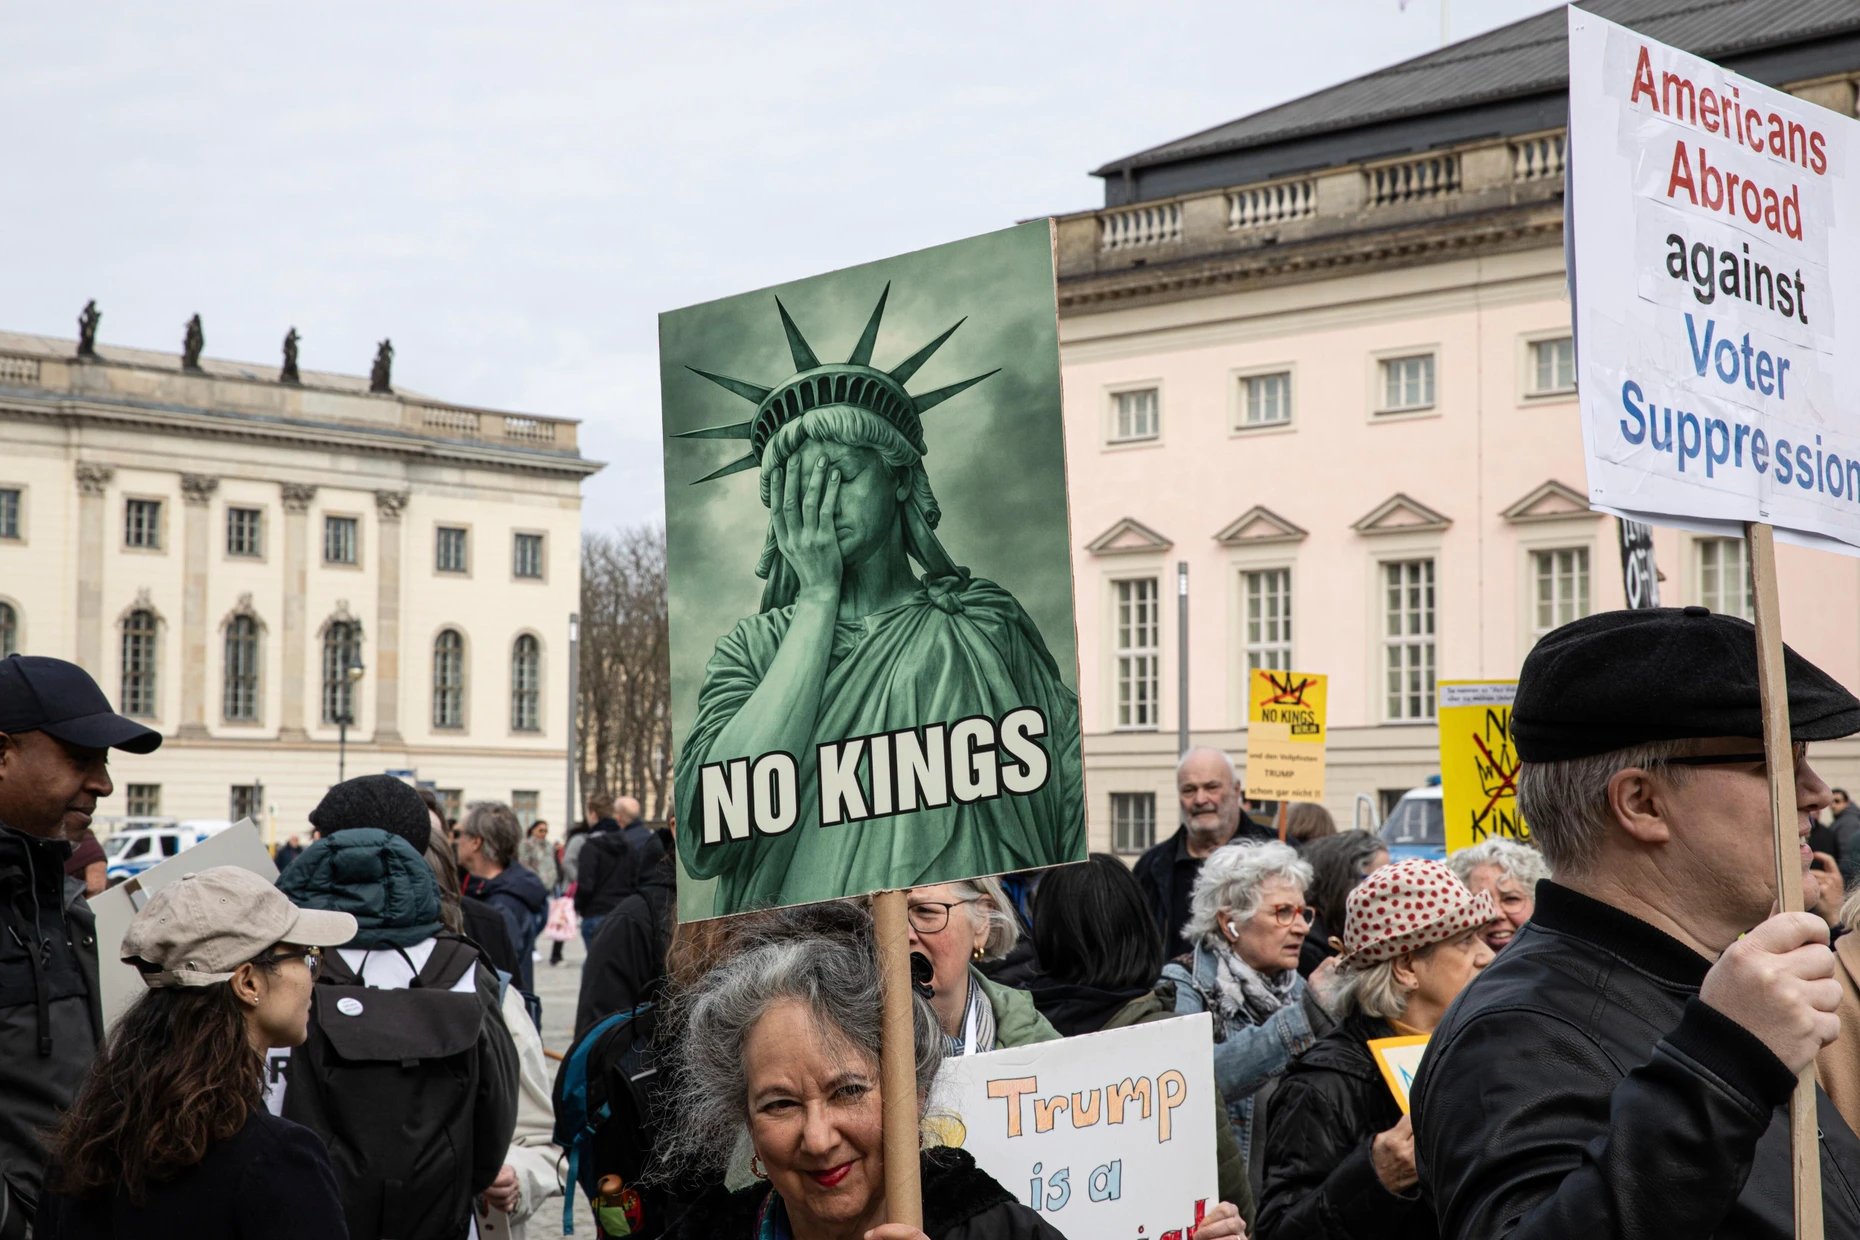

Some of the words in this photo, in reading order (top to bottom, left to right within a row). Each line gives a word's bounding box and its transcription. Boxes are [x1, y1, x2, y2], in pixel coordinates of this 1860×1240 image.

[1631, 46, 1828, 175] Americans
[1667, 140, 1803, 241] Abroad
[1666, 233, 1808, 325] against
[1684, 312, 1790, 400] Voter
[1620, 379, 1860, 504] Suppression
[1262, 708, 1277, 723] NO
[1281, 710, 1315, 724] KINGS
[699, 750, 801, 848] NO
[816, 705, 1051, 828] KINGS
[1249, 787, 1273, 796] schon
[1276, 789, 1289, 798] gar
[1292, 789, 1312, 798] nicht
[1264, 769, 1295, 778] TRUMP
[986, 1069, 1187, 1144] Trump
[1030, 1162, 1071, 1212] is
[1088, 1158, 1122, 1202] a
